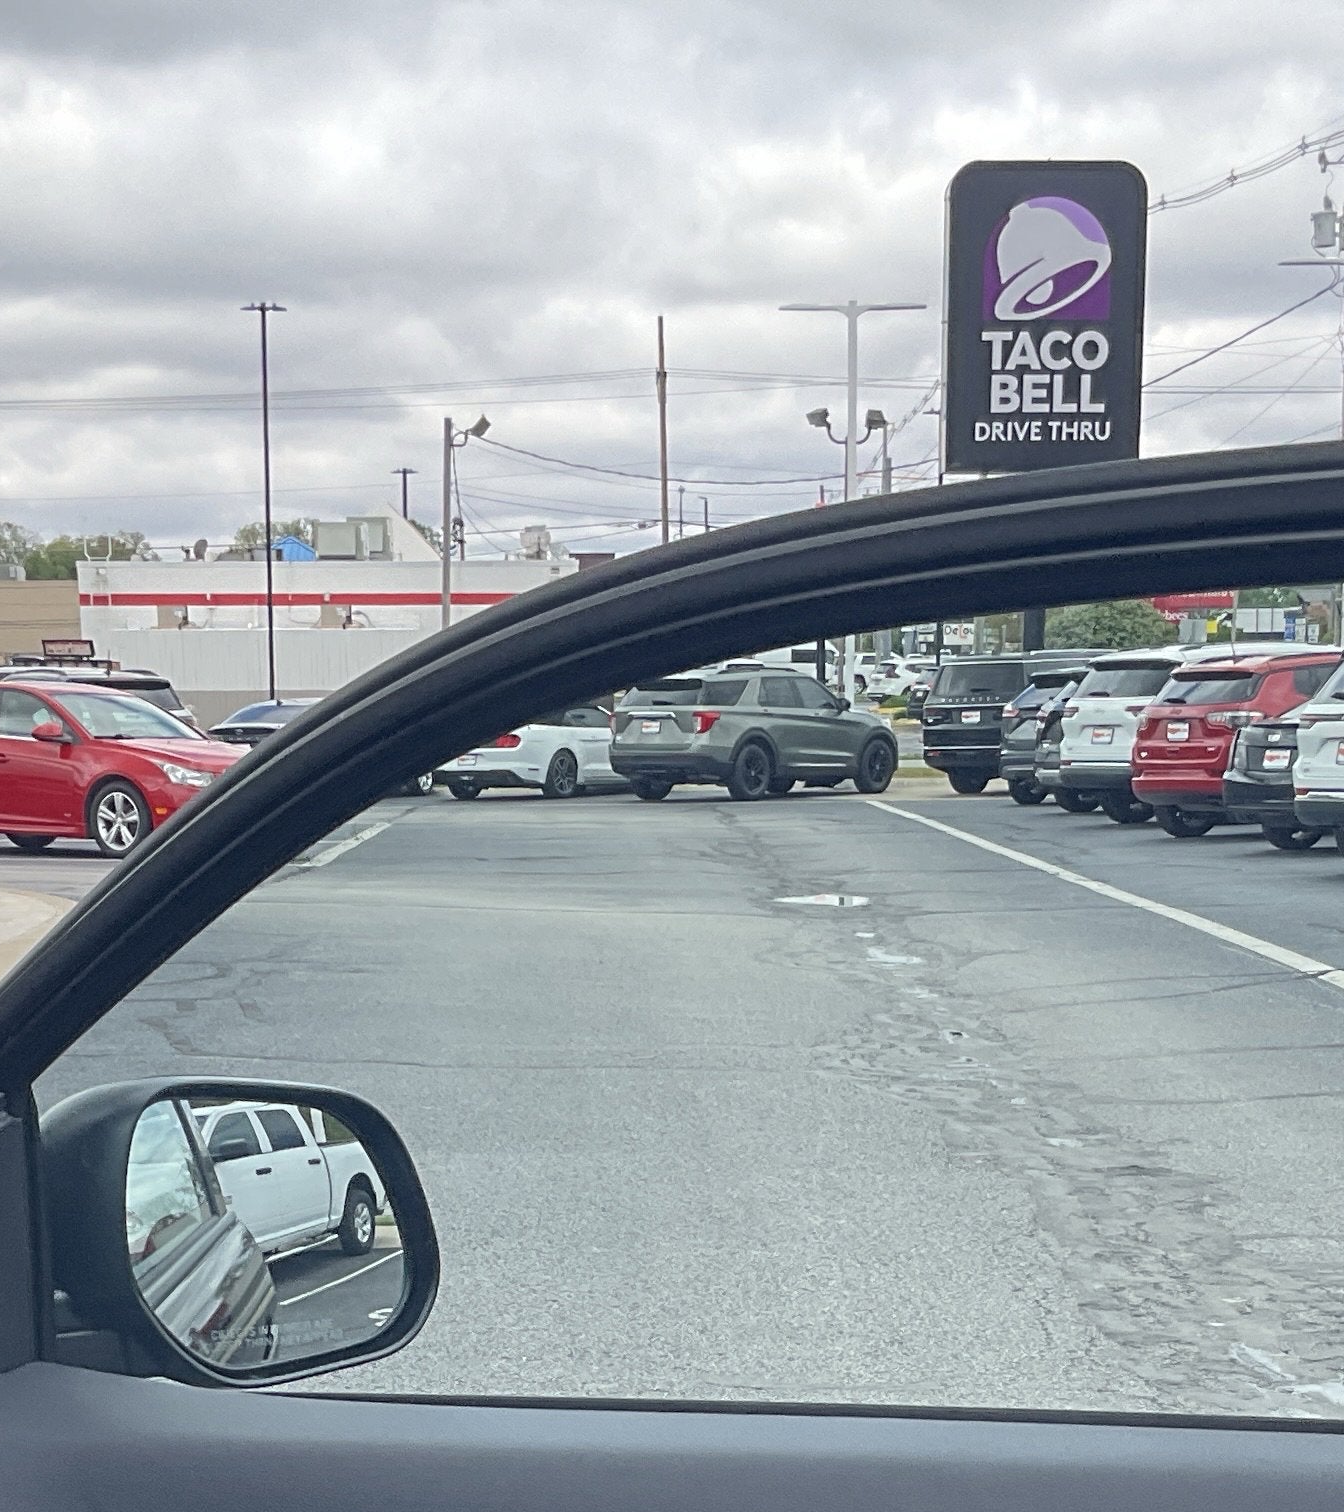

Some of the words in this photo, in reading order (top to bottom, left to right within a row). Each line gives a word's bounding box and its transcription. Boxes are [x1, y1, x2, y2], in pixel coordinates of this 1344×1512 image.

[981, 330, 1109, 371] TACO
[989, 374, 1106, 413] BELL
[973, 420, 1043, 442] DRIVE
[1047, 420, 1112, 442] THRU
